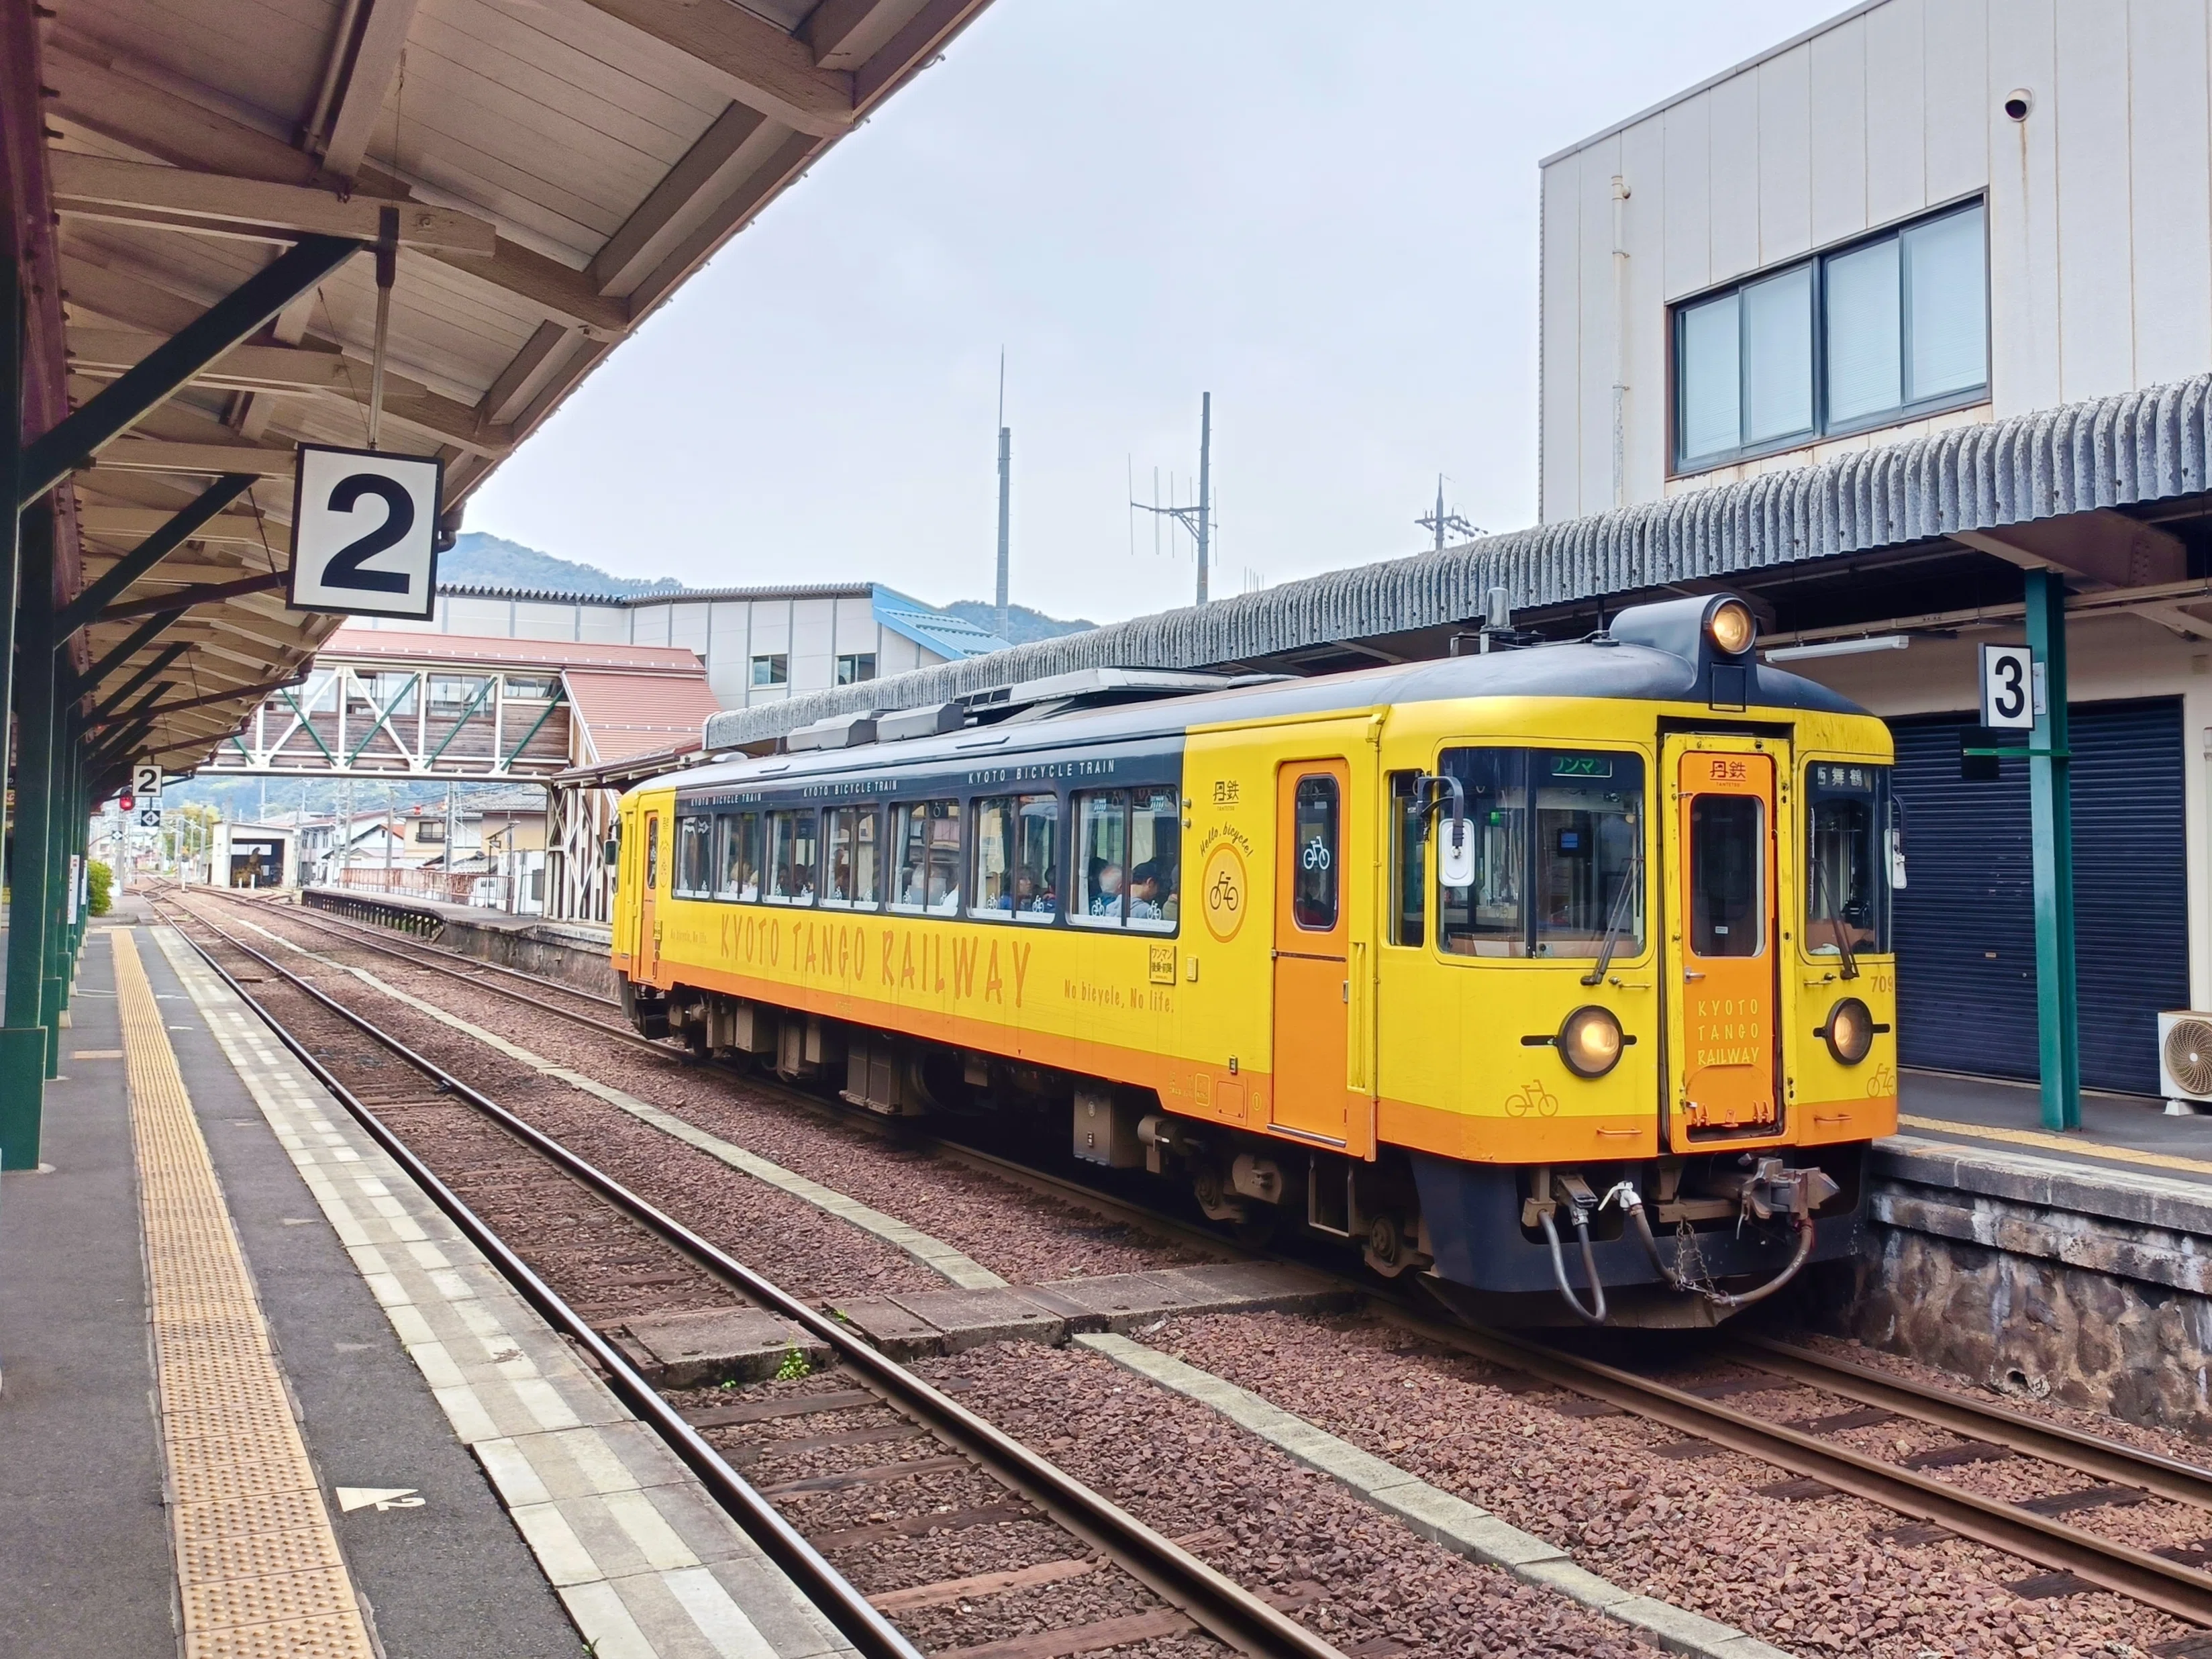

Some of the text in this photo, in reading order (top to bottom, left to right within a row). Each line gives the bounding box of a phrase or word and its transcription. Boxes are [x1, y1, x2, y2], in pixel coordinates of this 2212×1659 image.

[320, 473, 414, 594] 2
[1995, 656, 2025, 718] 3
[968, 760, 1115, 784] KYOTO BICYCLE TRAIN
[1710, 760, 1746, 778] 丹鉄
[138, 769, 157, 793] 2
[803, 780, 897, 797] KYOTO BICYCLE TRAIN
[1213, 780, 1240, 802] 丹鉄
[713, 795, 738, 805] BICYCLE
[742, 793, 762, 803] TRAIN
[146, 814, 153, 823] 4
[1223, 821, 1254, 858] bicycle!
[721, 913, 1031, 1008] KYOTO TANGO RAILWAY
[1152, 948, 1173, 960] ワンマン
[1870, 975, 1893, 993] 709
[1064, 979, 1174, 1013] No bicycle, No life.
[1697, 999, 1758, 1017] KYOTO
[1697, 1023, 1758, 1042] TANGO
[1697, 1046, 1760, 1066] RAILWAY
